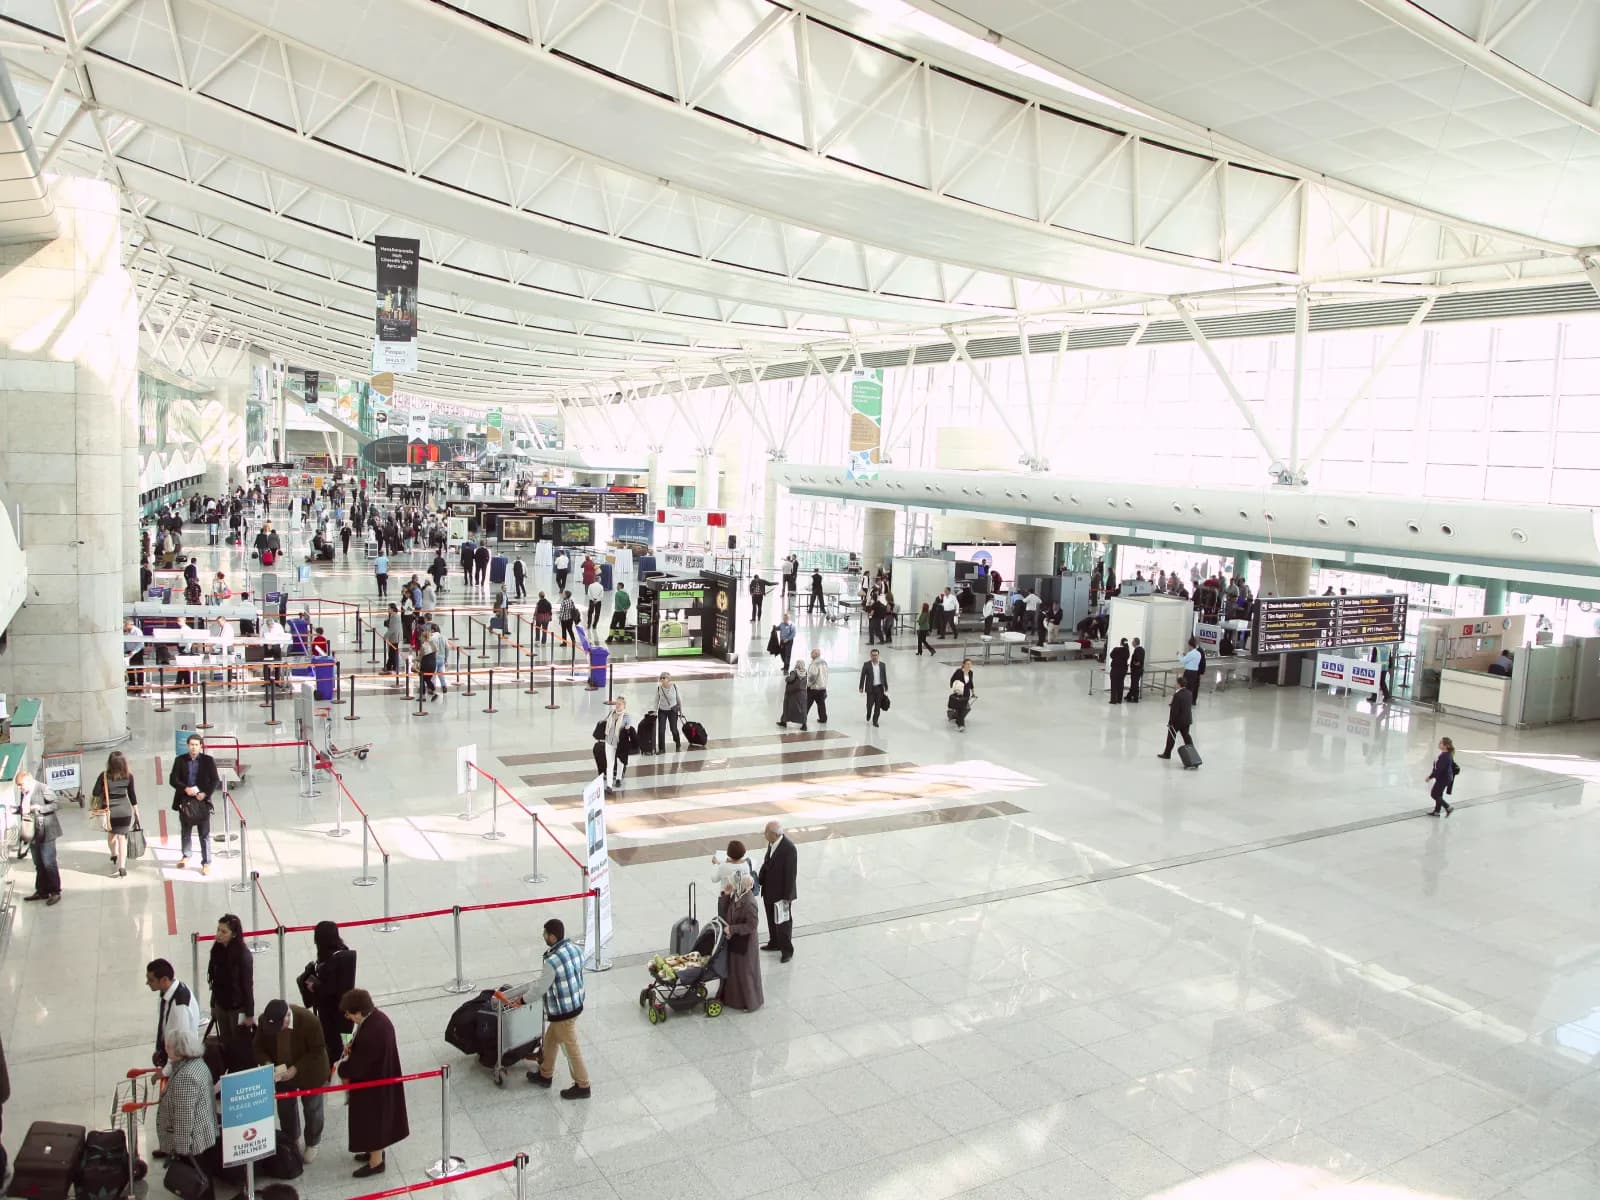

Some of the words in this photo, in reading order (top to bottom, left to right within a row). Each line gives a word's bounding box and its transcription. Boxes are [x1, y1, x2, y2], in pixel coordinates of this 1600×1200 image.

[671, 582, 704, 590] TrueStar
[1322, 661, 1344, 672] TAV
[1352, 666, 1376, 678] TAV
[52, 768, 74, 778] TAV
[229, 1101, 251, 1112] PLEASE
[233, 1138, 267, 1150] TURKISH
[233, 1144, 268, 1156] AIRLINES
